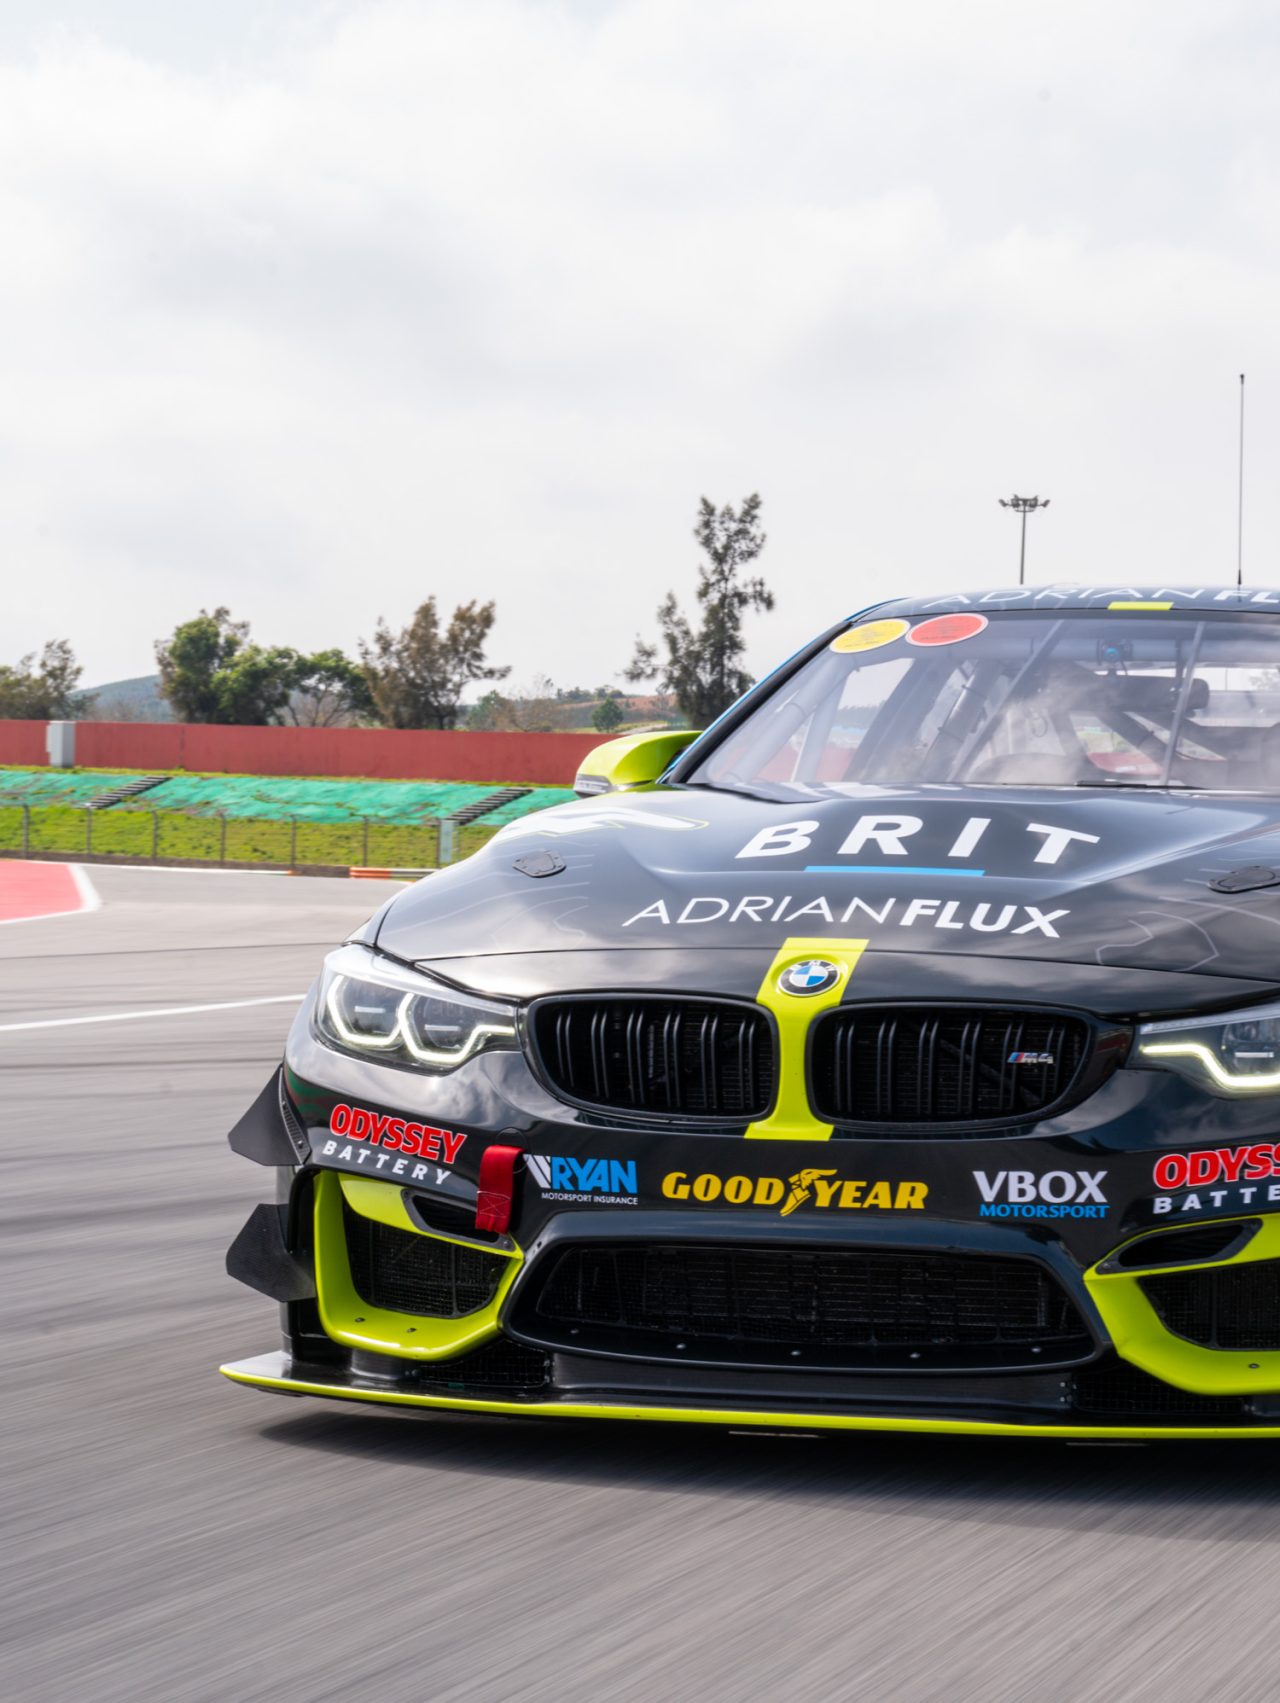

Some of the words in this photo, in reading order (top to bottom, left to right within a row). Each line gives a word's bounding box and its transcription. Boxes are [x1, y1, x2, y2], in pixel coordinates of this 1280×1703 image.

[736, 814, 1101, 865] BRIT
[622, 895, 1071, 940] ADRIANFLUX
[329, 1103, 468, 1165] ODYSSEY
[321, 1139, 451, 1186] BATTERY
[552, 1156, 638, 1195] RYAN
[541, 1192, 592, 1203] MOTORSPORT
[593, 1195, 639, 1205] INSURANCE
[973, 1170, 1109, 1204] VBOX
[979, 1203, 1110, 1219] MOTORSPORT
